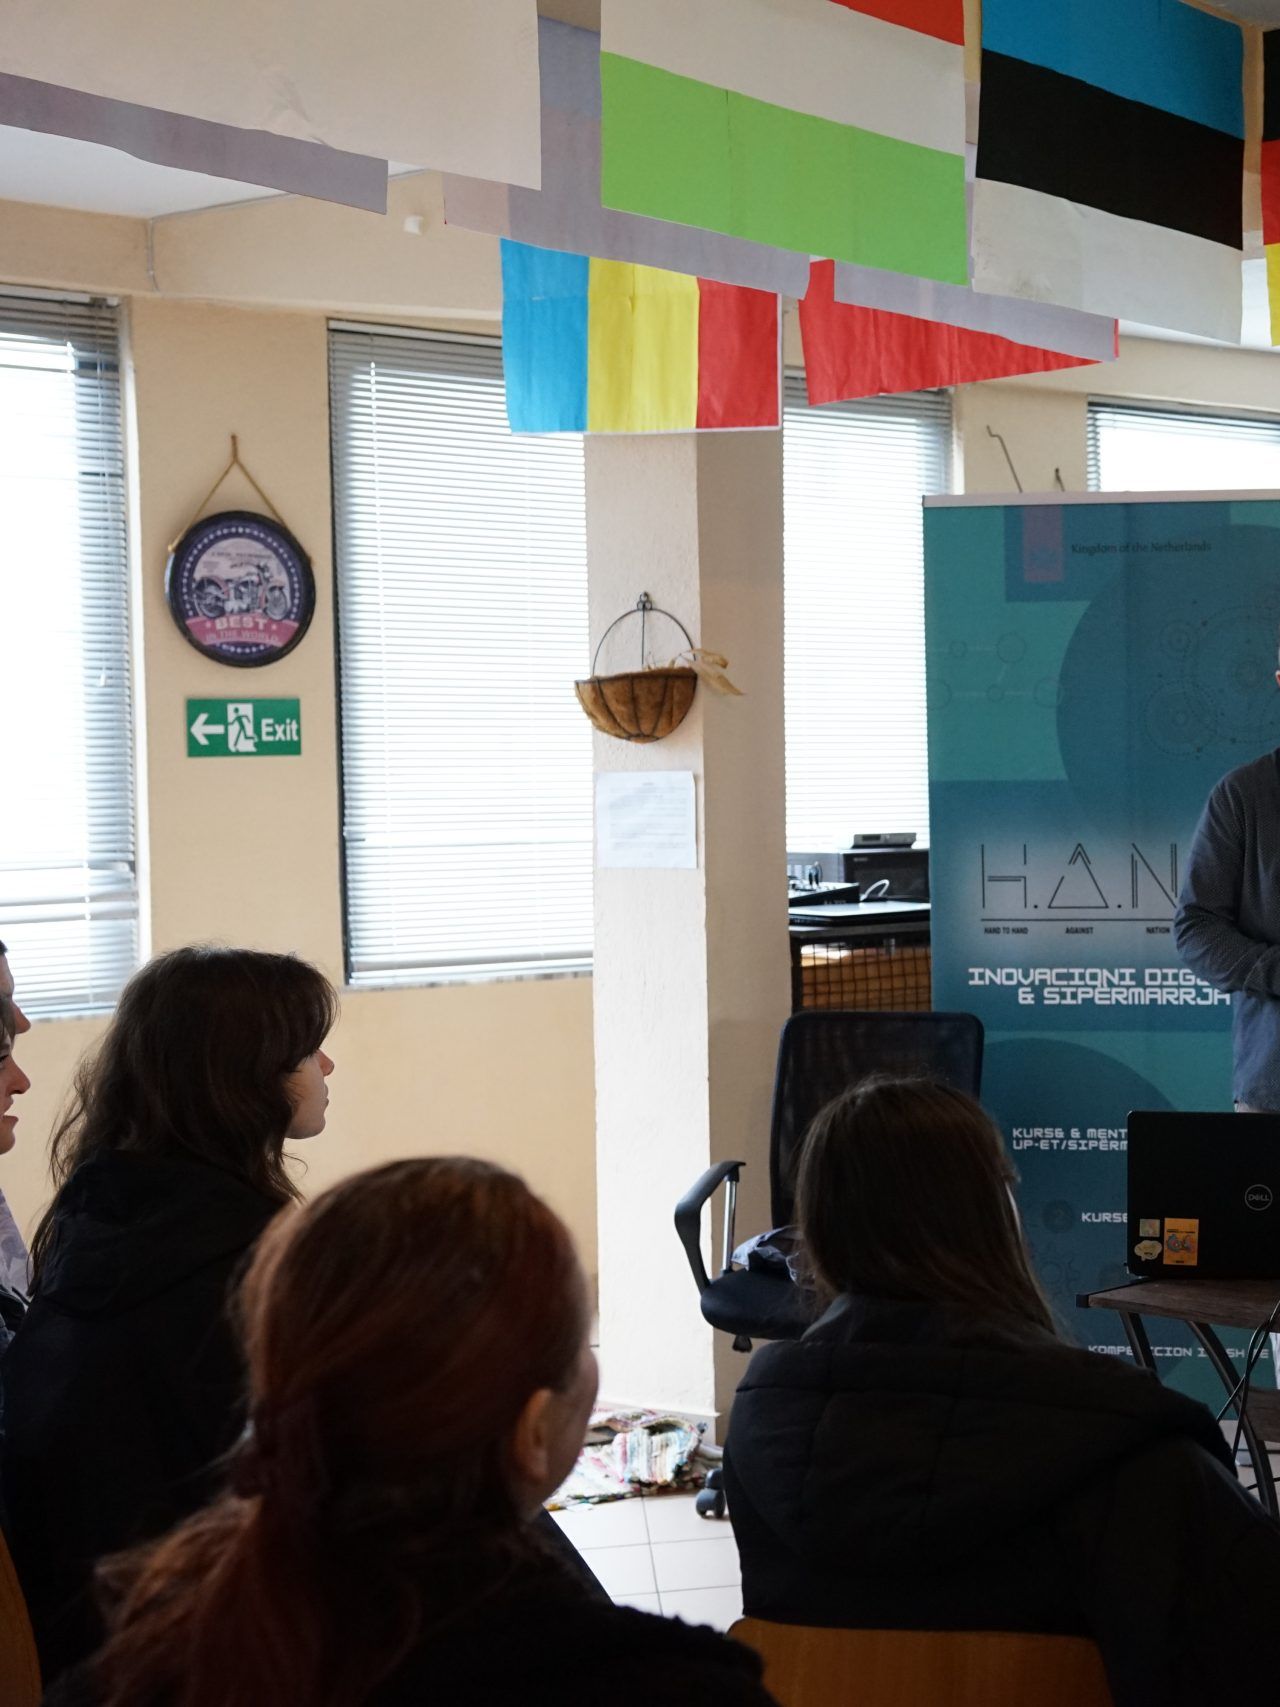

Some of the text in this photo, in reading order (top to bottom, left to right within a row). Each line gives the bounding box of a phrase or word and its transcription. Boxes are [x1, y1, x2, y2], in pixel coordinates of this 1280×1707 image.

[1071, 540, 1212, 556] Kingdom of the Netherlands
[215, 615, 268, 631] BEST
[261, 718, 299, 741] Exit
[1065, 926, 1094, 935] AGAINST
[1146, 926, 1171, 935] NATION
[968, 967, 1136, 986] INOVACIONI
[1017, 987, 1035, 1005] &
[1070, 1128, 1081, 1138] &
[1248, 1193, 1270, 1201] DELL
